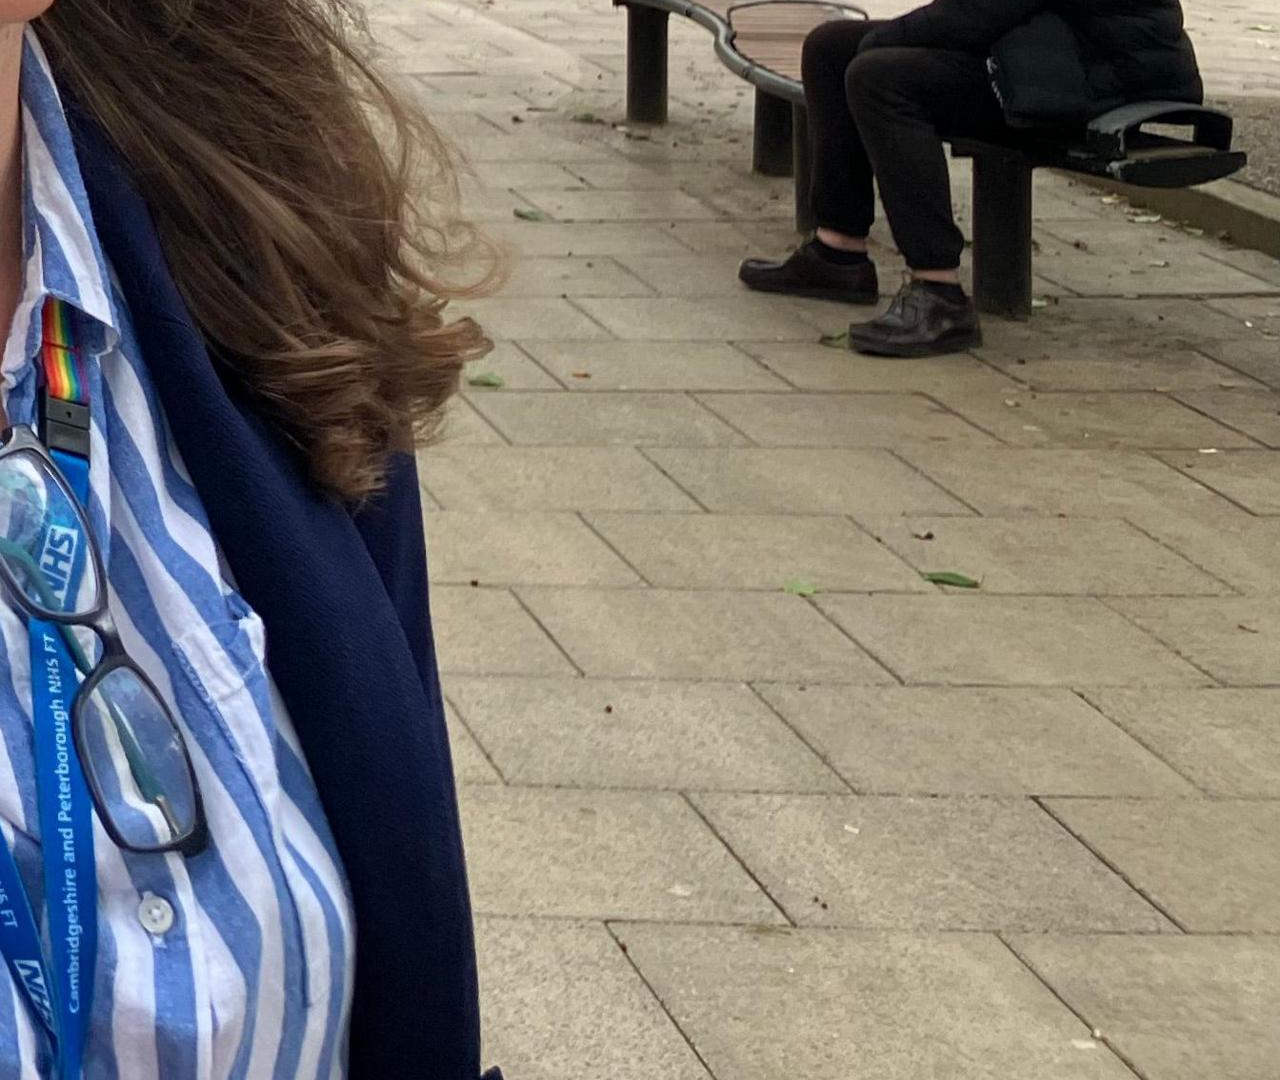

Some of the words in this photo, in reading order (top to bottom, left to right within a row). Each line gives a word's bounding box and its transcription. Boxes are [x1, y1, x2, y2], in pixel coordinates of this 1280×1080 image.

[43, 633, 57, 653] FT
[46, 658, 62, 694] NHS
[48, 699, 74, 822] Peterborough
[58, 828, 75, 863] and
[0, 909, 18, 927] FT
[62, 869, 83, 1014] Cambridgeshire
